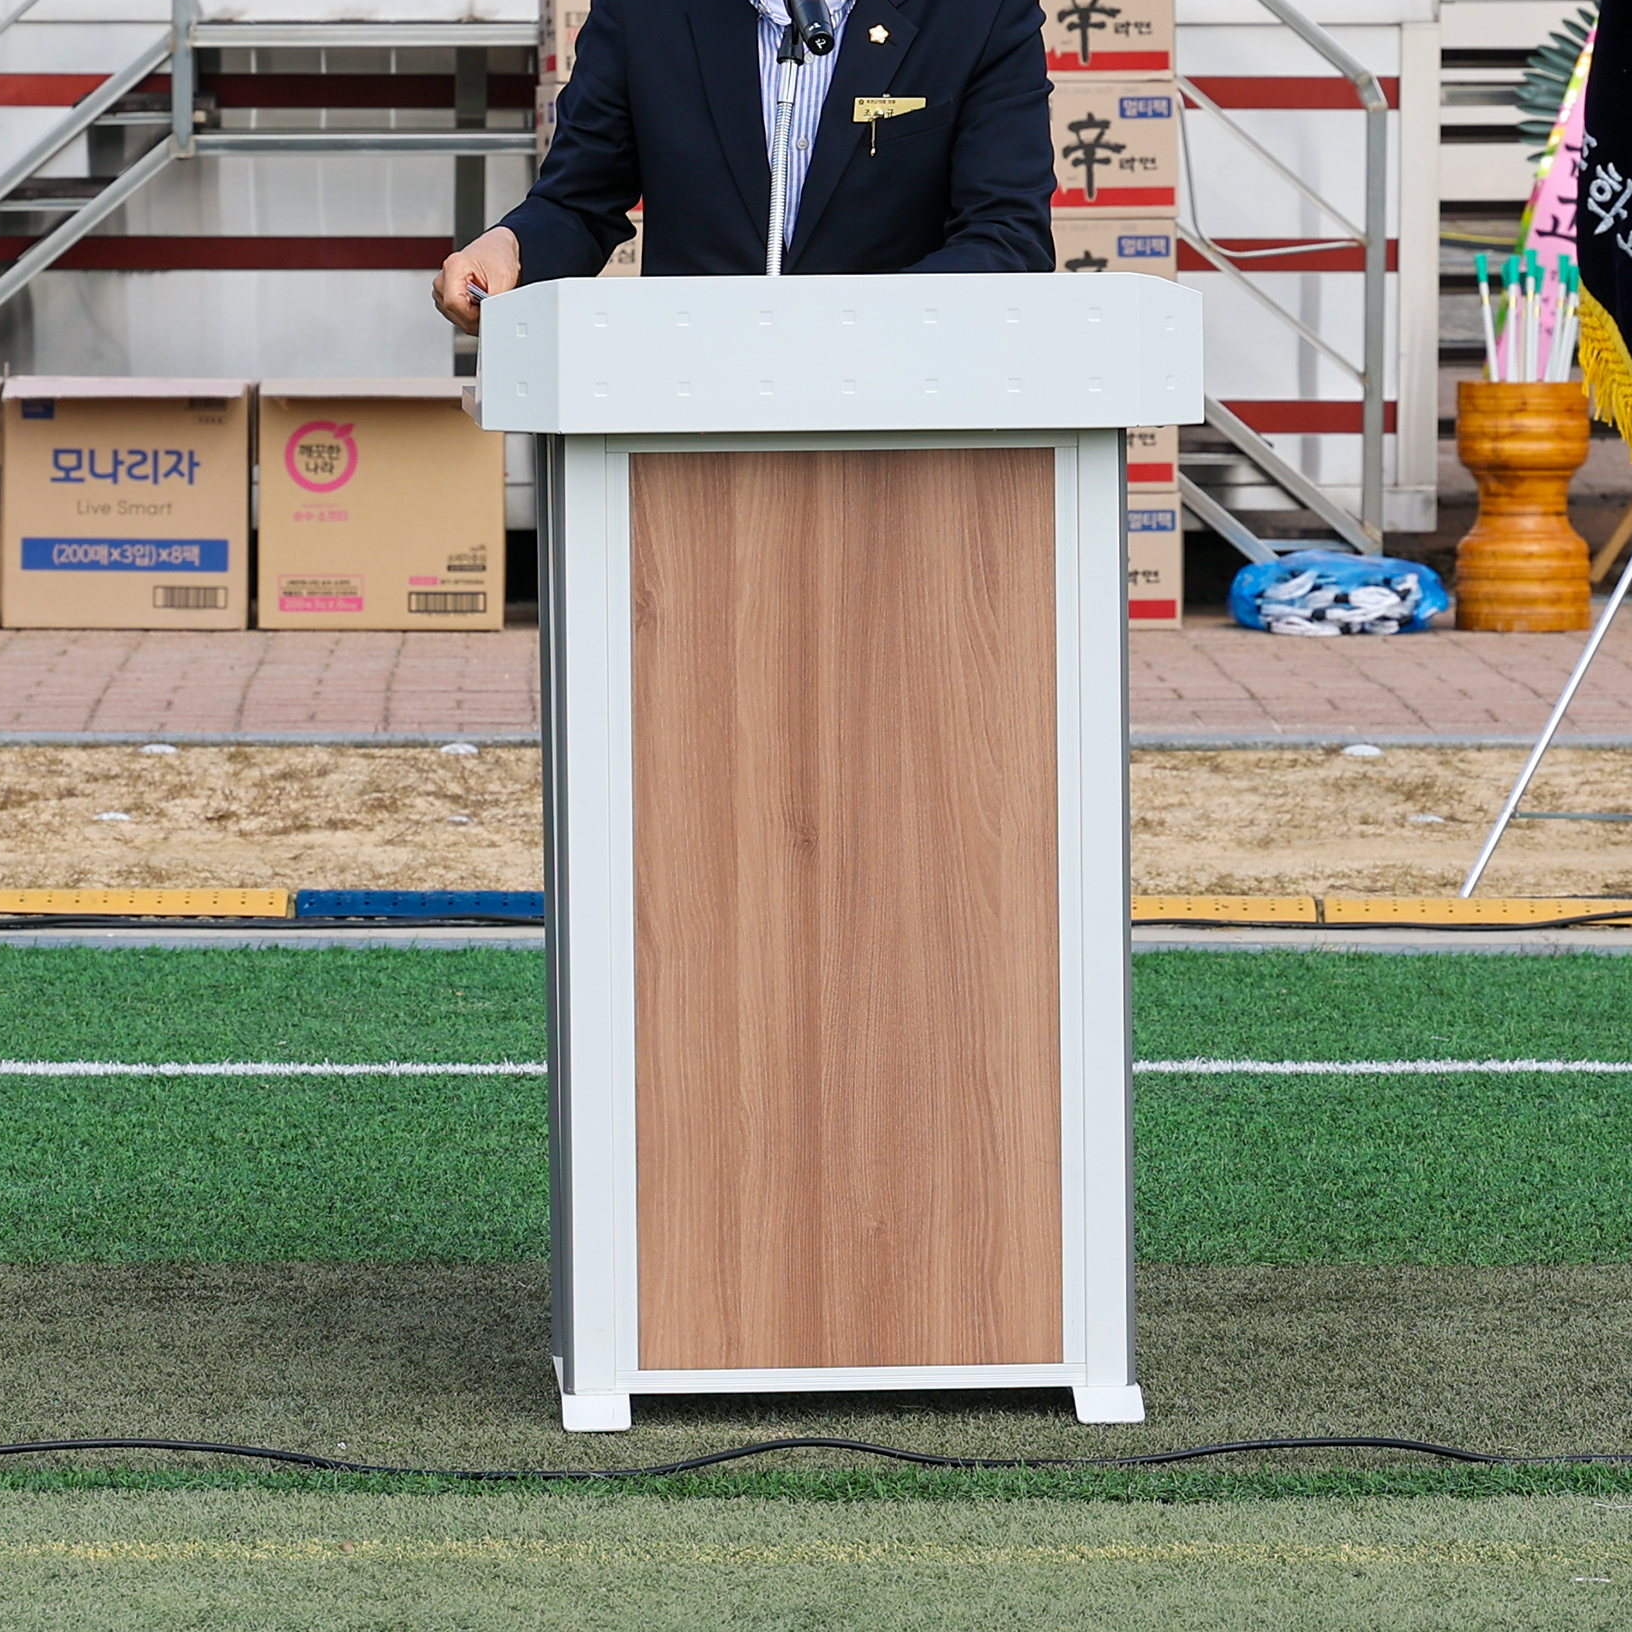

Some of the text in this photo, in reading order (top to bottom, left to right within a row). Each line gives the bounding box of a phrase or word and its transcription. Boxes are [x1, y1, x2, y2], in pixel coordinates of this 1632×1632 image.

[1113, 21, 1153, 37] 라면
[1120, 99, 1171, 117] 멀티팩
[1062, 111, 1158, 200] 辛 라면
[1119, 237, 1168, 256] 멀티팩
[297, 443, 341, 461] 깨끗한
[49, 448, 201, 485] 모나리자
[304, 461, 335, 475] 나라
[76, 499, 173, 516] Live Smart
